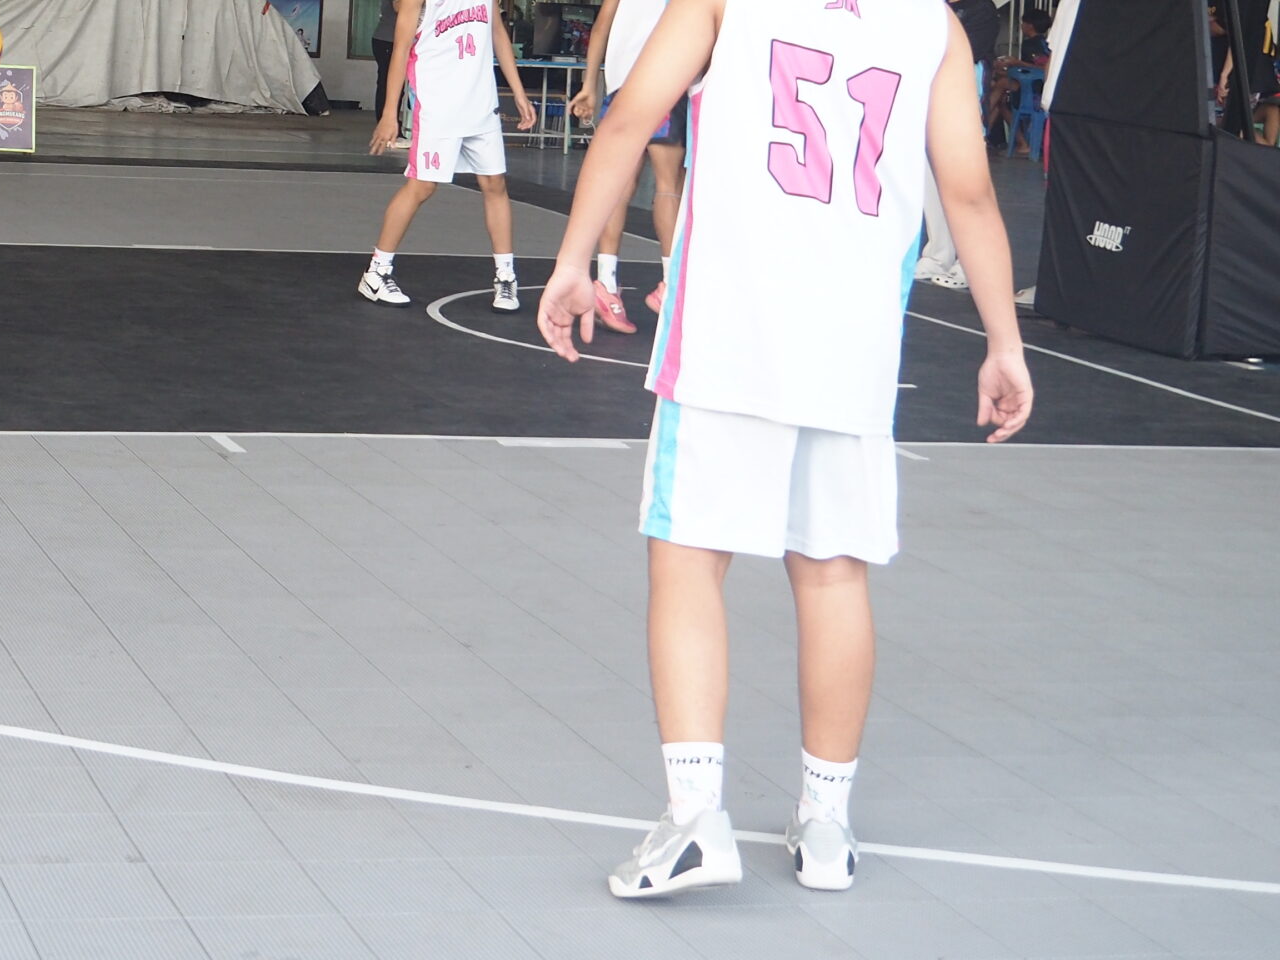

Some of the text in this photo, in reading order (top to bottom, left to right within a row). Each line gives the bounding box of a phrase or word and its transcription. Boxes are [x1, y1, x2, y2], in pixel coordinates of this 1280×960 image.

[455, 32, 477, 60] 14
[767, 38, 902, 217] 51
[422, 151, 441, 170] 14
